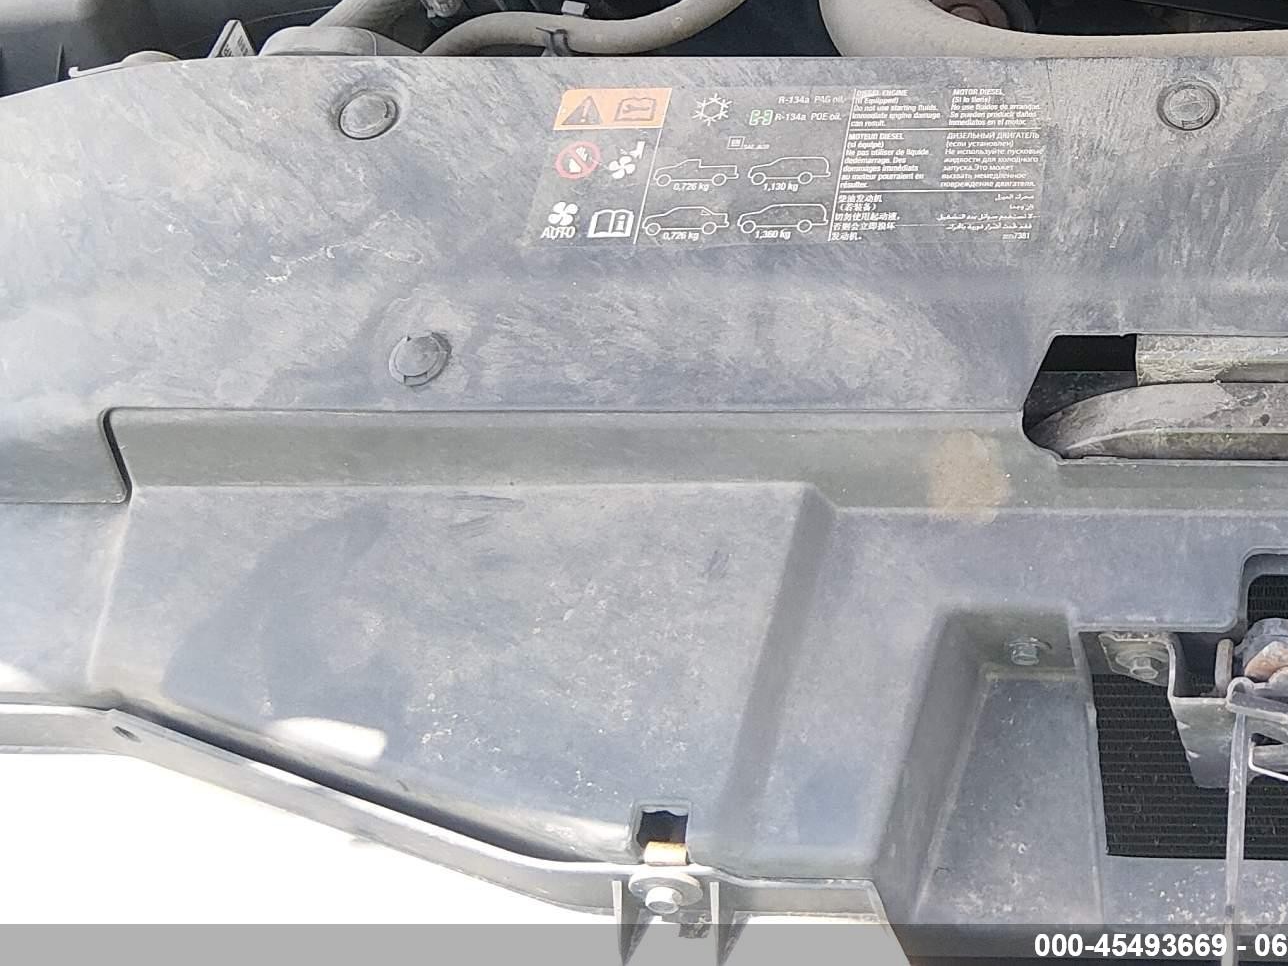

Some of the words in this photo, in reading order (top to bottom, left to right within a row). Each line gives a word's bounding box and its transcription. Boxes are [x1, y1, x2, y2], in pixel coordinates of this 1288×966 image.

[778, 95, 810, 104] R-134a
[775, 112, 807, 121] R-134a
[810, 112, 828, 121] POE
[673, 182, 697, 192] 0,726
[699, 183, 710, 193] kg
[764, 182, 786, 191] 1,130
[788, 183, 799, 192] kg
[541, 225, 576, 239] AUTO
[662, 232, 686, 241] 0,726
[688, 232, 699, 242] kg
[780, 230, 791, 240] kg
